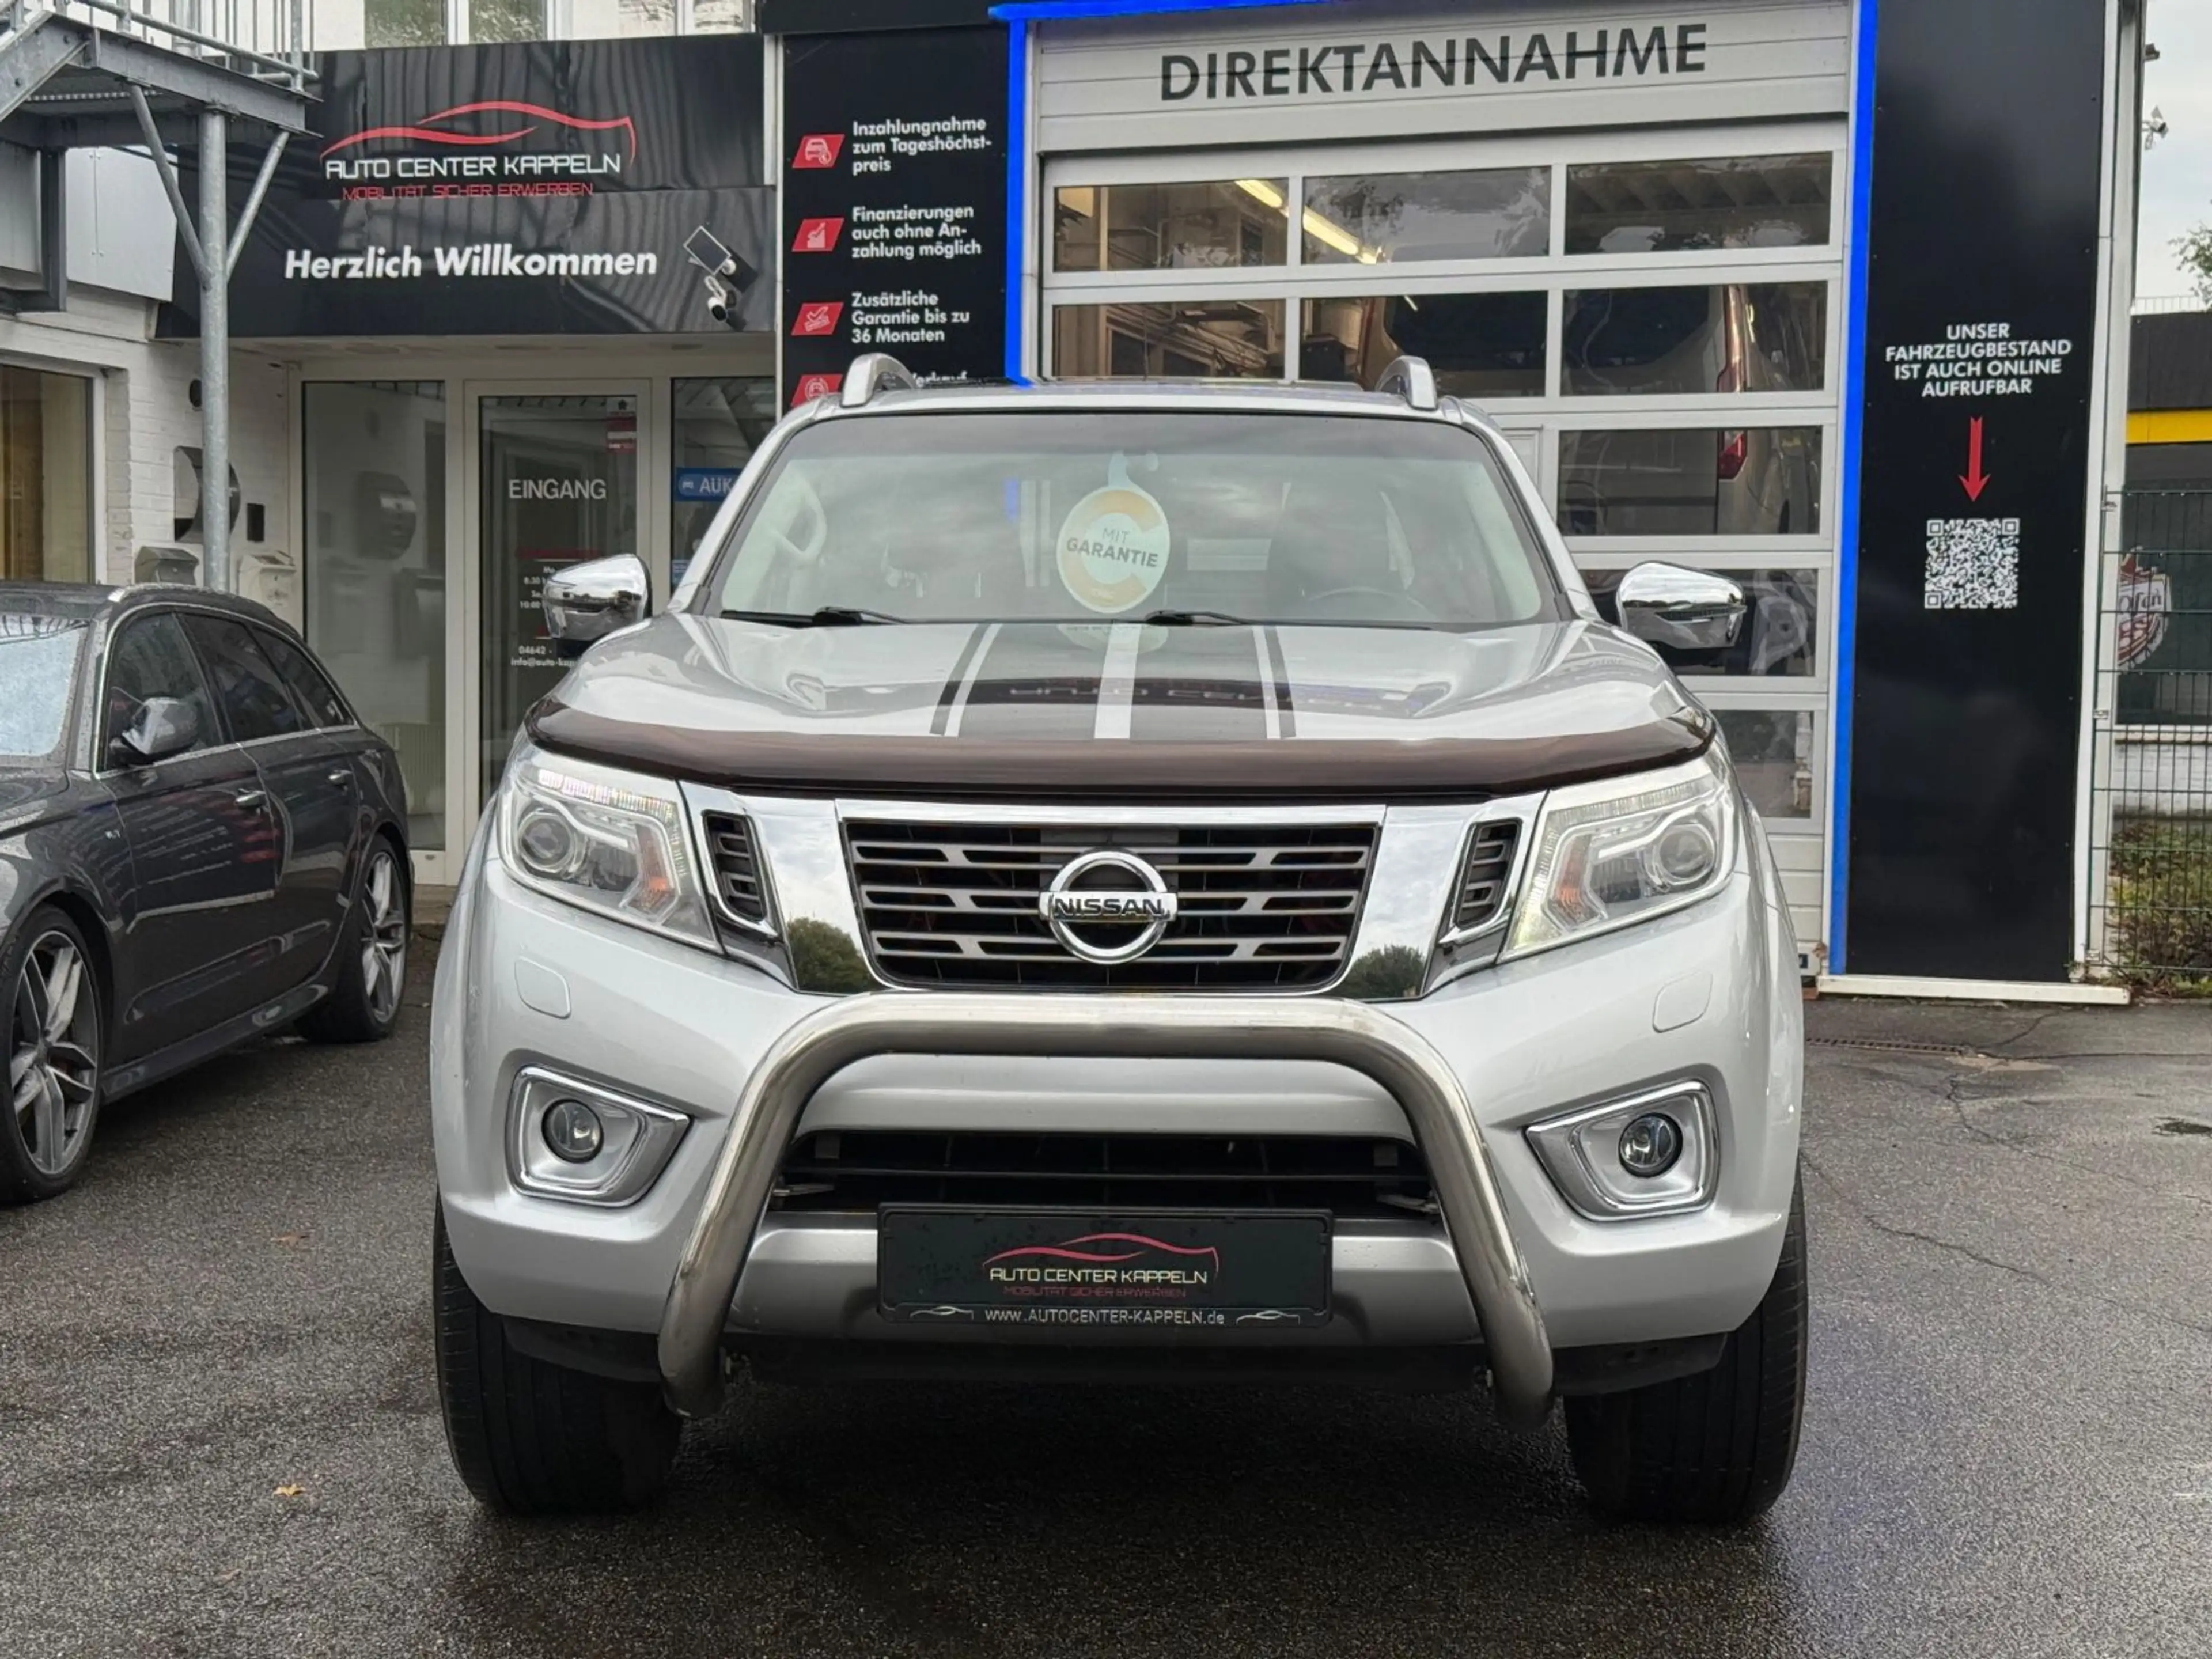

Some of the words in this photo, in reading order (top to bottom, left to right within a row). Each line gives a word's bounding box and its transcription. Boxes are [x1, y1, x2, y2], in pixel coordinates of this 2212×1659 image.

[1161, 24, 1707, 101] DIREKTANNAHME
[853, 117, 987, 137] Inzahlungnahme
[853, 142, 885, 154] zum
[890, 135, 991, 156] Tageshöchst-
[327, 159, 390, 179] AUTO
[397, 157, 496, 177] CENTER
[505, 154, 620, 175] KAPPELN
[853, 157, 891, 176] preis
[433, 184, 493, 199] SICHER
[498, 182, 593, 197] ERWERBEN
[853, 205, 974, 223] Finanzierungen
[852, 224, 889, 240] auch
[895, 223, 934, 238] ohne
[938, 221, 967, 237] An-
[852, 242, 914, 260] zahlung
[919, 239, 981, 259] möglich
[286, 245, 422, 278] Herzlich
[434, 244, 657, 275] Willkommen
[852, 290, 938, 306] Zusätzliche
[852, 309, 919, 325] Garantie
[925, 308, 947, 323] bis
[952, 312, 969, 322] zu
[852, 329, 871, 343] 36
[876, 328, 944, 342] Monaten
[1948, 323, 2009, 340] UNSER
[1885, 339, 2072, 362] FAHRZEUGBESTAND
[1895, 364, 1921, 379] IST
[1926, 362, 1981, 378] AUCH
[1987, 358, 2061, 376] ONLINE
[1922, 377, 2031, 397] AUFRUFBAR
[509, 479, 606, 499] EINGANG
[1103, 527, 1130, 543] MIT
[1066, 537, 1158, 568] GARANTIE
[1054, 898, 1165, 916] NISSAN
[990, 1268, 1041, 1282] AUTO
[1044, 1268, 1118, 1283] CENTER
[1121, 1270, 1207, 1284] KAPPELN
